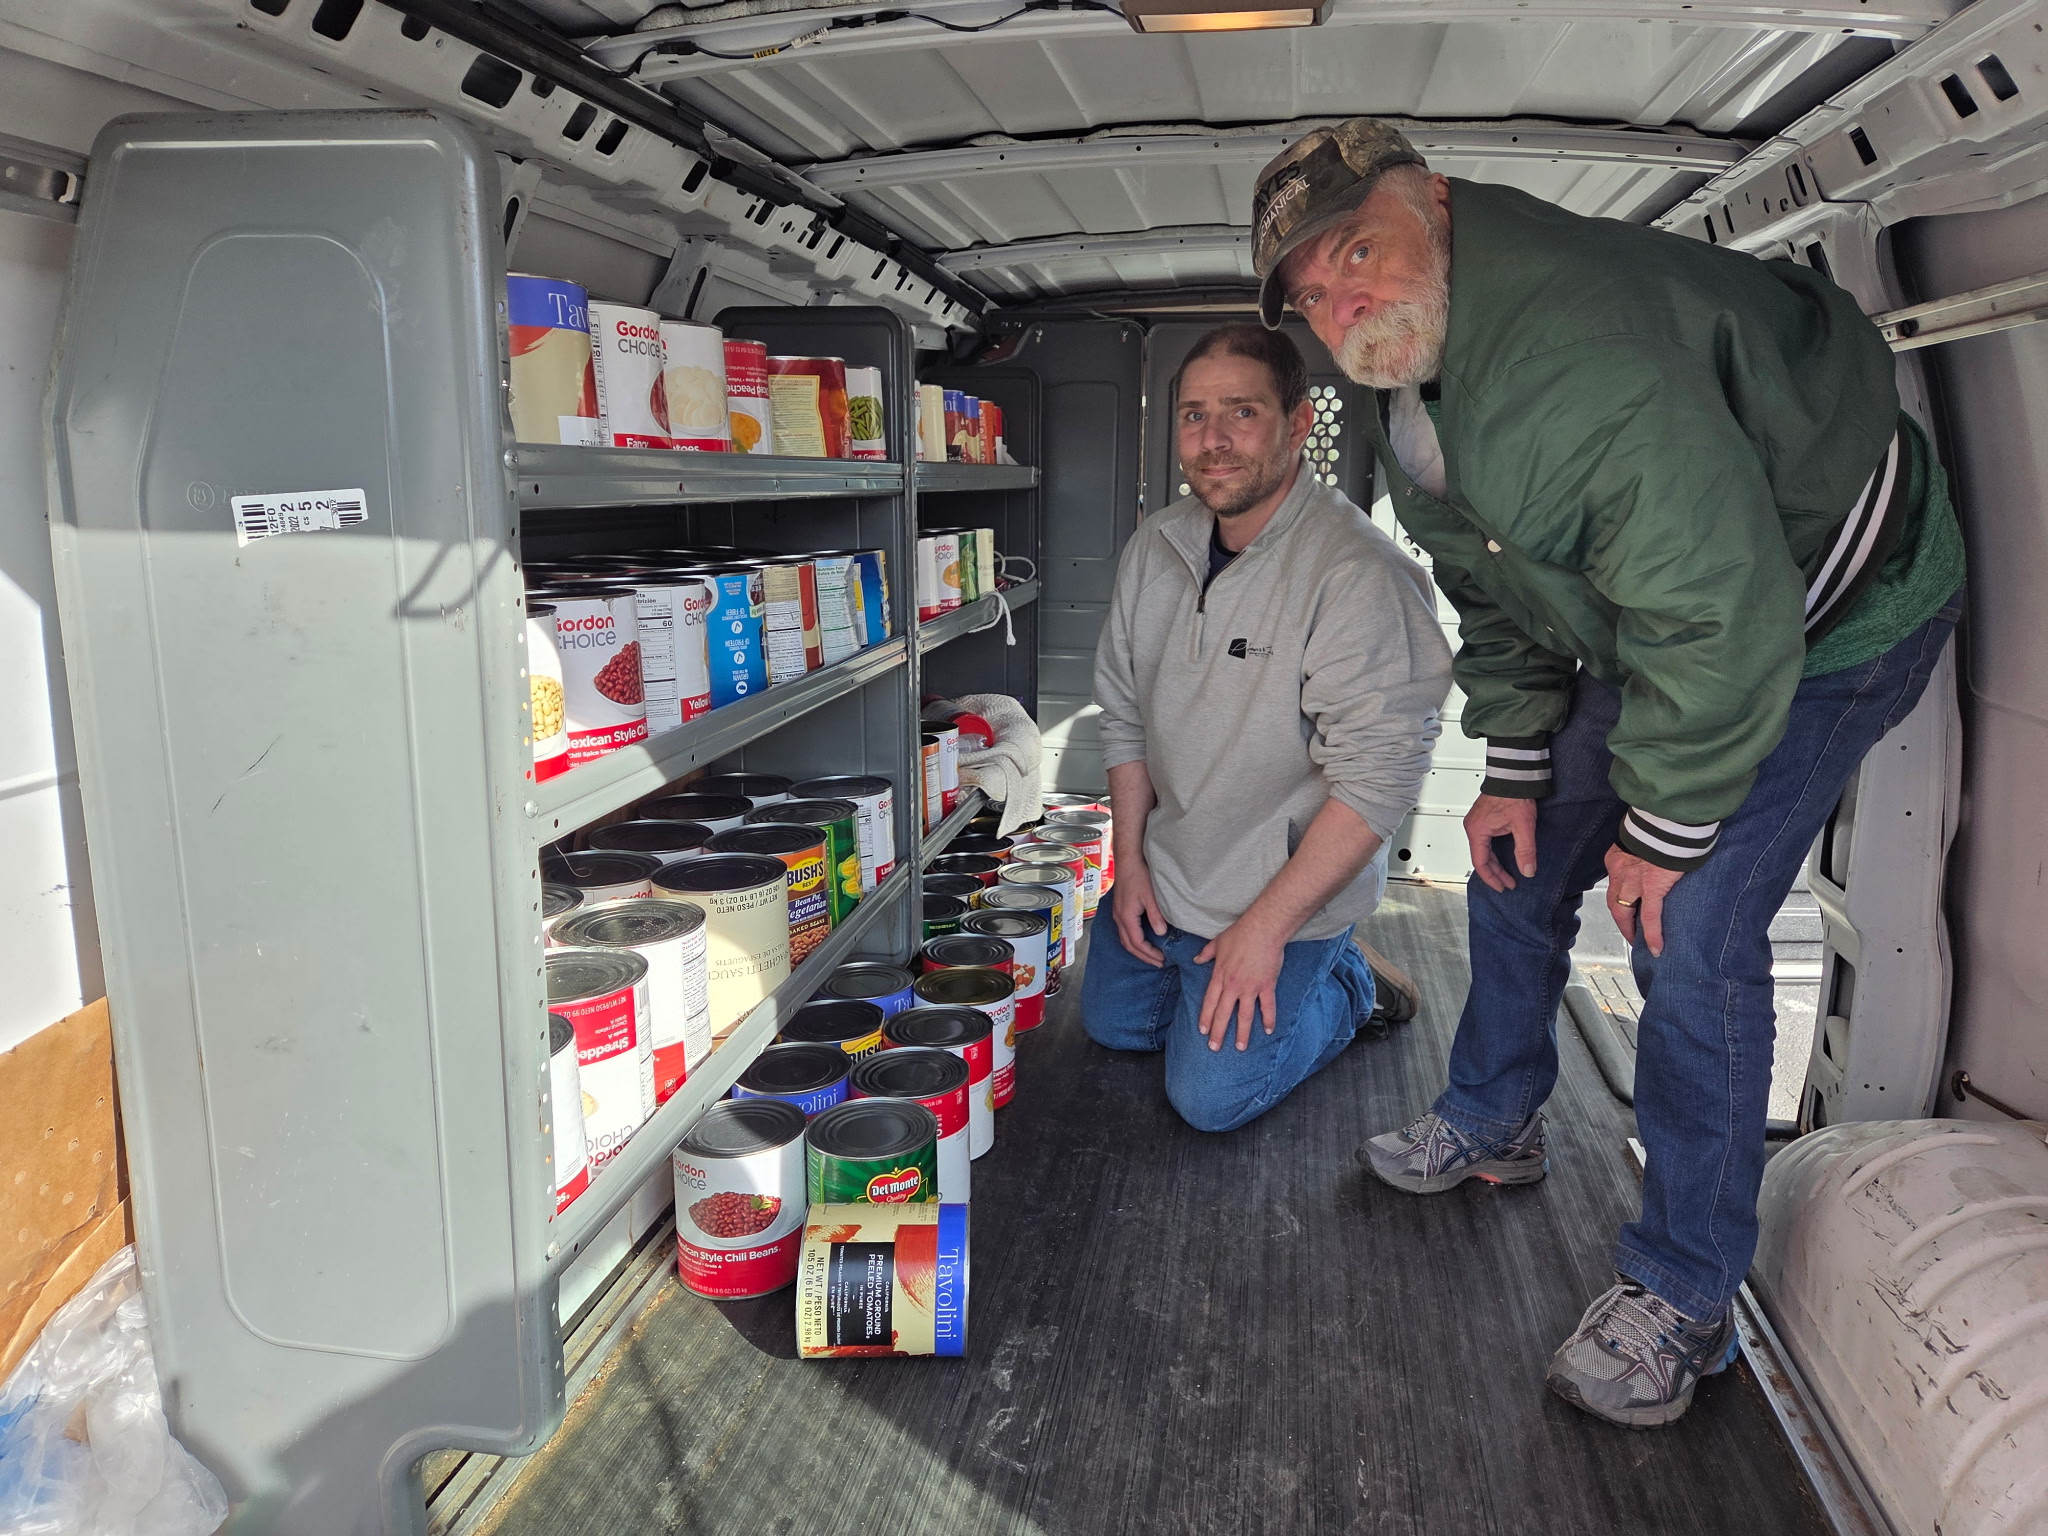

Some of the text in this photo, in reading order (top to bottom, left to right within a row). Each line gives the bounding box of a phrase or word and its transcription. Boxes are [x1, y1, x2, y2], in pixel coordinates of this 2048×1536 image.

[1259, 178, 1311, 247] CHANICAL
[547, 291, 590, 330] Tav
[615, 320, 660, 343] Gordon
[567, 734, 612, 749] exican
[613, 726, 636, 743] Style
[787, 860, 825, 888] BUSH'S
[802, 880, 814, 889] BEST
[716, 905, 735, 914] NETO
[736, 902, 754, 911] PESO
[987, 1004, 1010, 1018] ordon
[798, 1088, 838, 1115] olini
[871, 1175, 919, 1197] Del Monte
[699, 1250, 723, 1263] Style
[724, 1252, 747, 1263] Chili
[807, 1248, 816, 1263] 105
[806, 1264, 814, 1275] OZ
[816, 1256, 825, 1274] NET
[804, 1277, 814, 1286] (6
[815, 1274, 823, 1288] WT
[805, 1287, 814, 1298] LB
[865, 1253, 876, 1336] PEELED TOMATOES
[873, 1254, 884, 1335] PREMIUM GROUND
[937, 1248, 960, 1339] Tavolini
[804, 1306, 813, 1320] OZ)
[813, 1296, 822, 1316] PESO
[804, 1321, 813, 1336] 2.98
[813, 1318, 822, 1336] NETO
